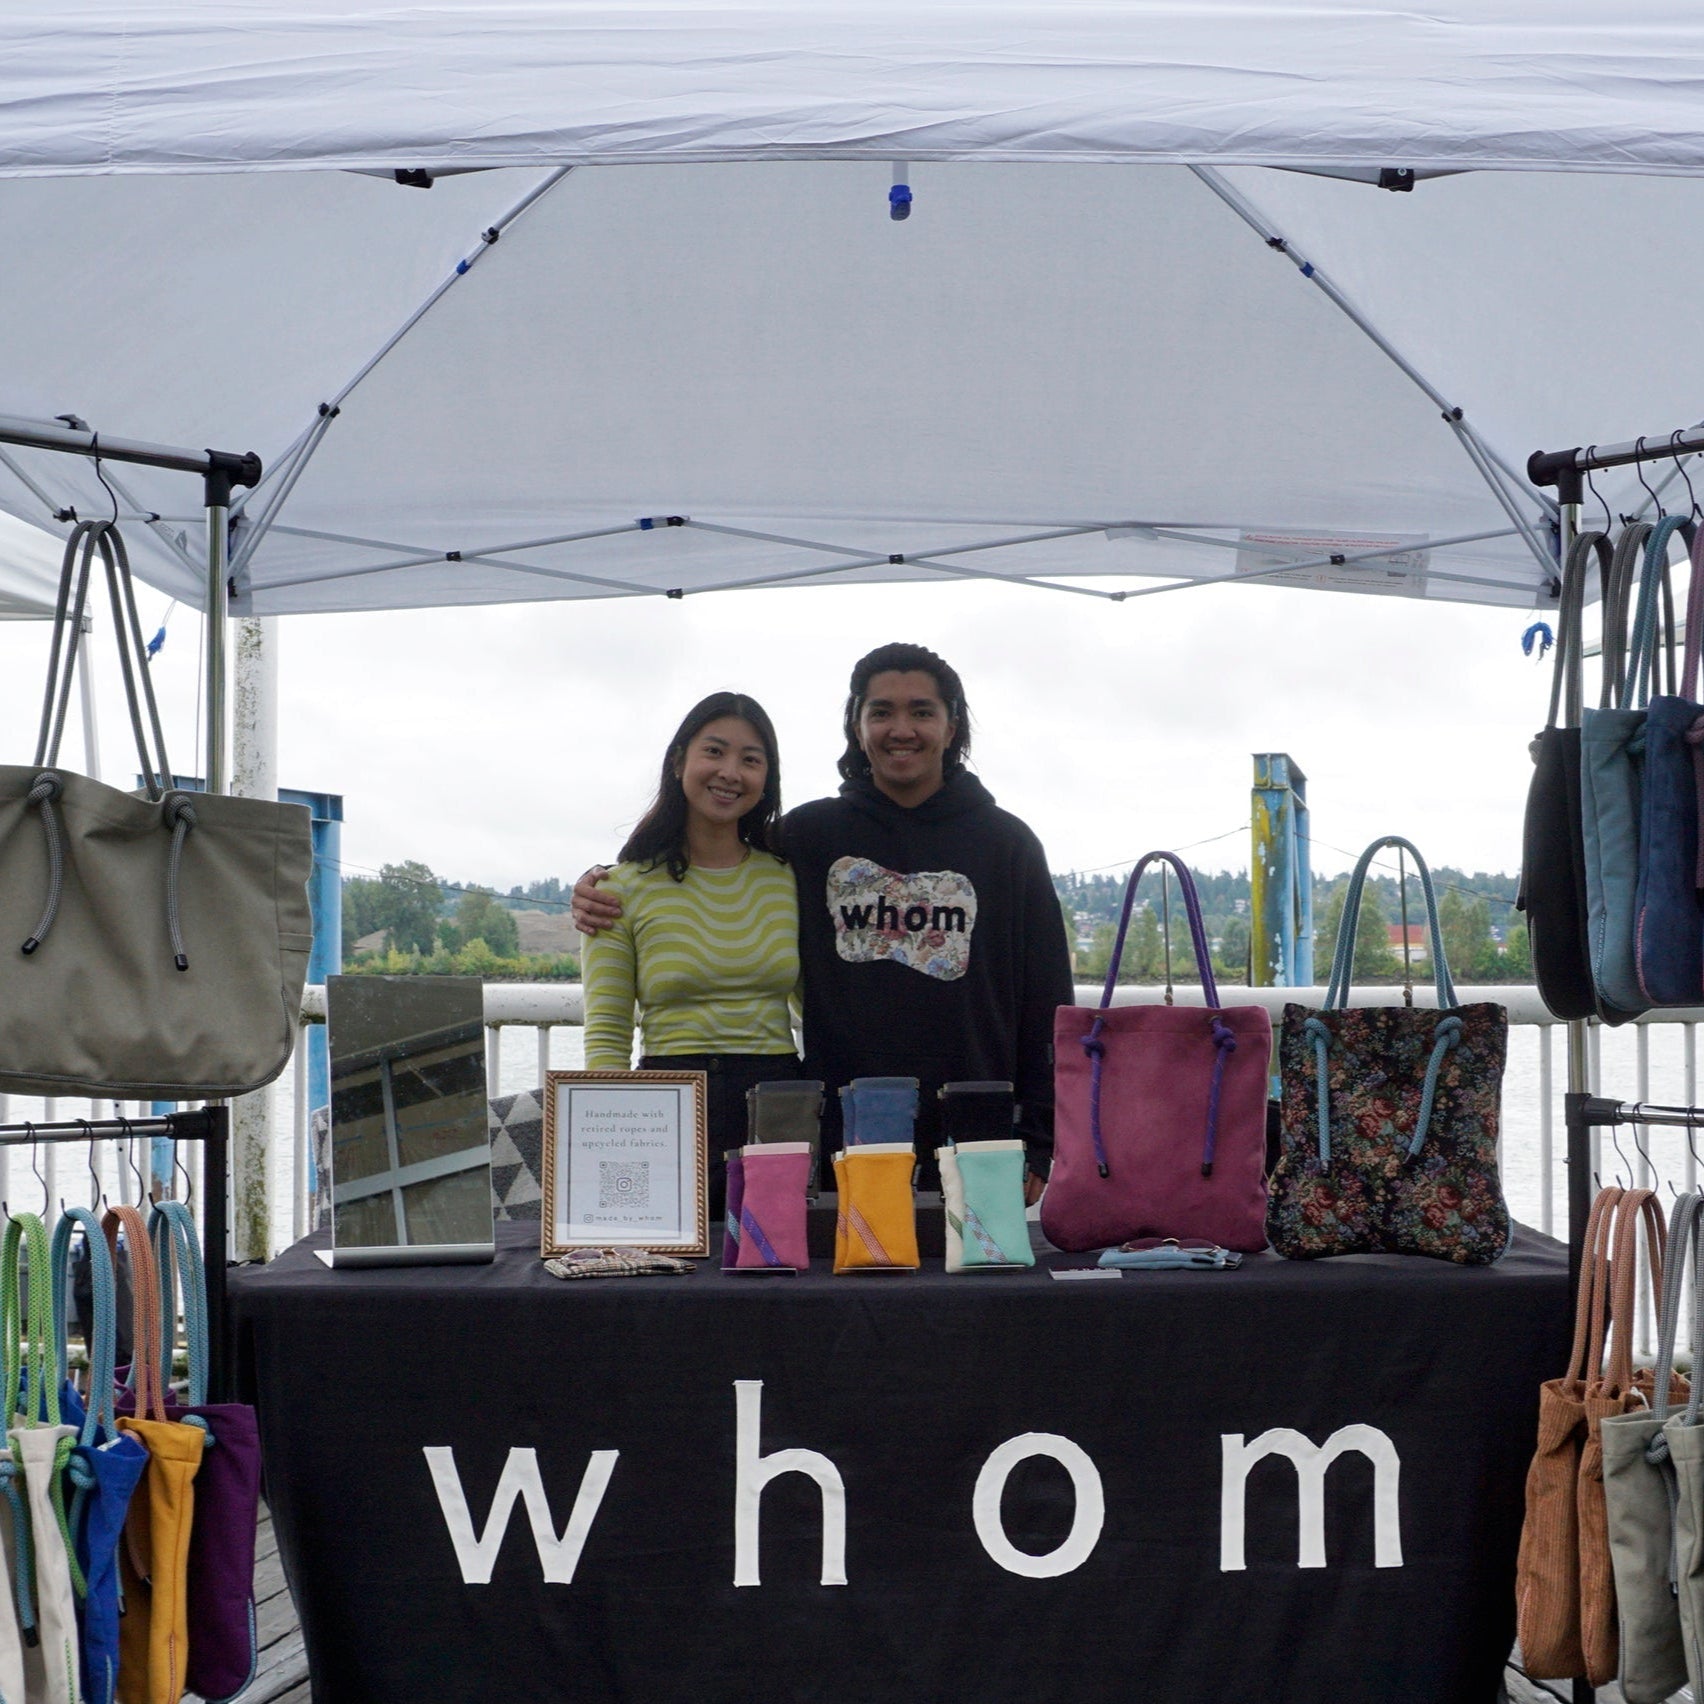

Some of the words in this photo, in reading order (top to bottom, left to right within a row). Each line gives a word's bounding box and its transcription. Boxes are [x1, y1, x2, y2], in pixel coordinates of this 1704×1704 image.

[840, 895, 966, 933] whom
[585, 1109, 638, 1118] Handmade
[642, 1109, 664, 1118] with
[581, 1125, 616, 1133] retired
[620, 1126, 647, 1135] ropes
[650, 1125, 668, 1133] and
[582, 1139, 626, 1149] upcycled
[630, 1139, 668, 1148] fabrics.
